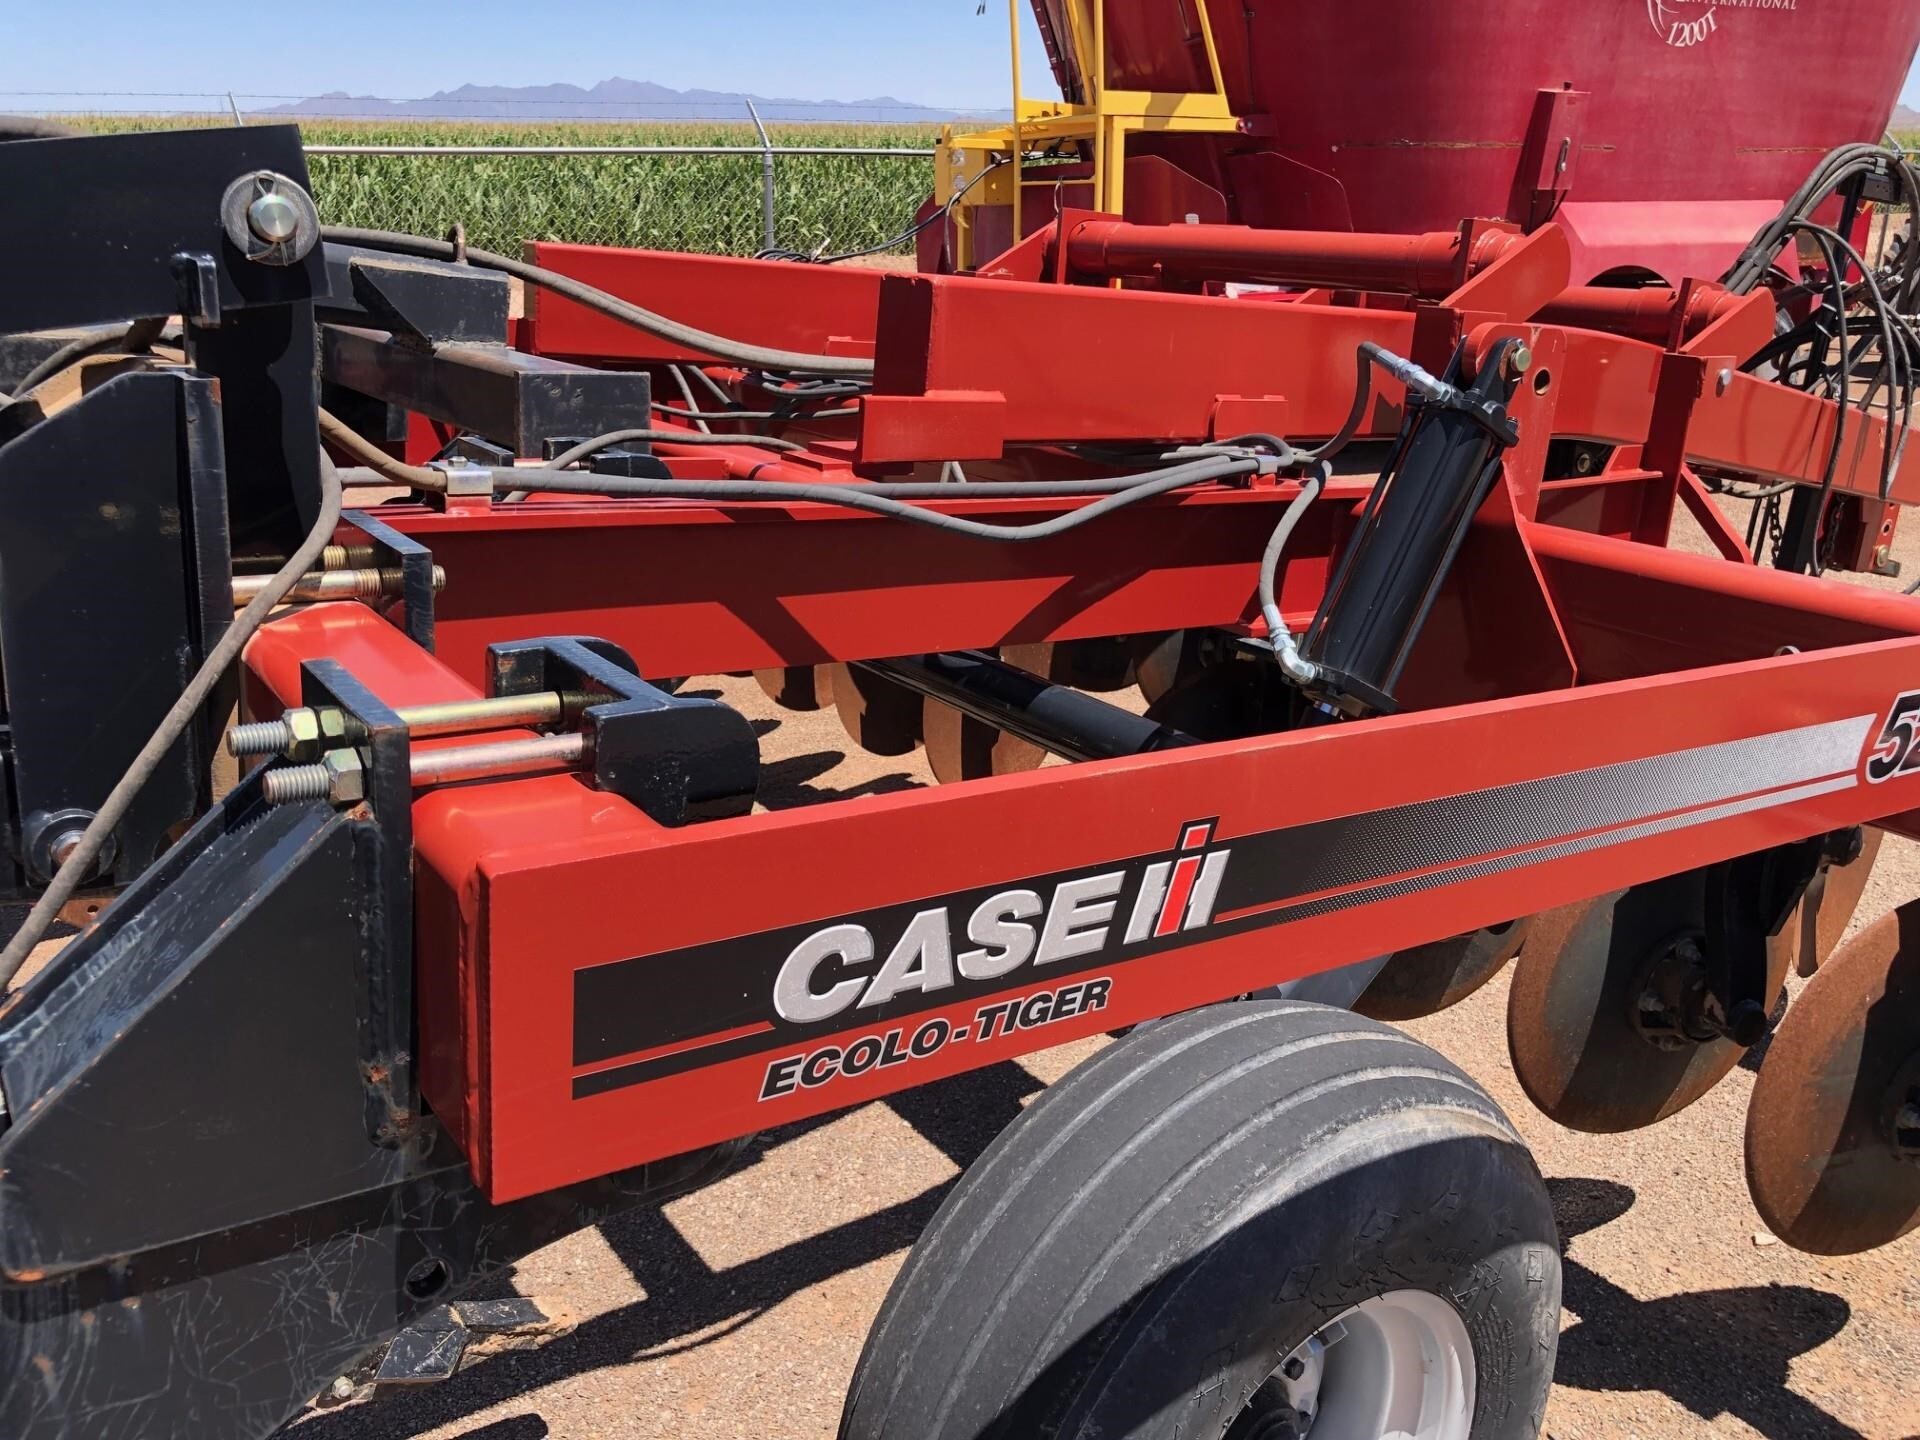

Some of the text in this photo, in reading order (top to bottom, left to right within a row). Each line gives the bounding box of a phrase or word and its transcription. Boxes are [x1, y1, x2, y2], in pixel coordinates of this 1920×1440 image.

[1666, 7, 1718, 47] 1200T
[773, 870, 1126, 1024] CASE
[758, 977, 1112, 1102] ECOLO-TIGER
